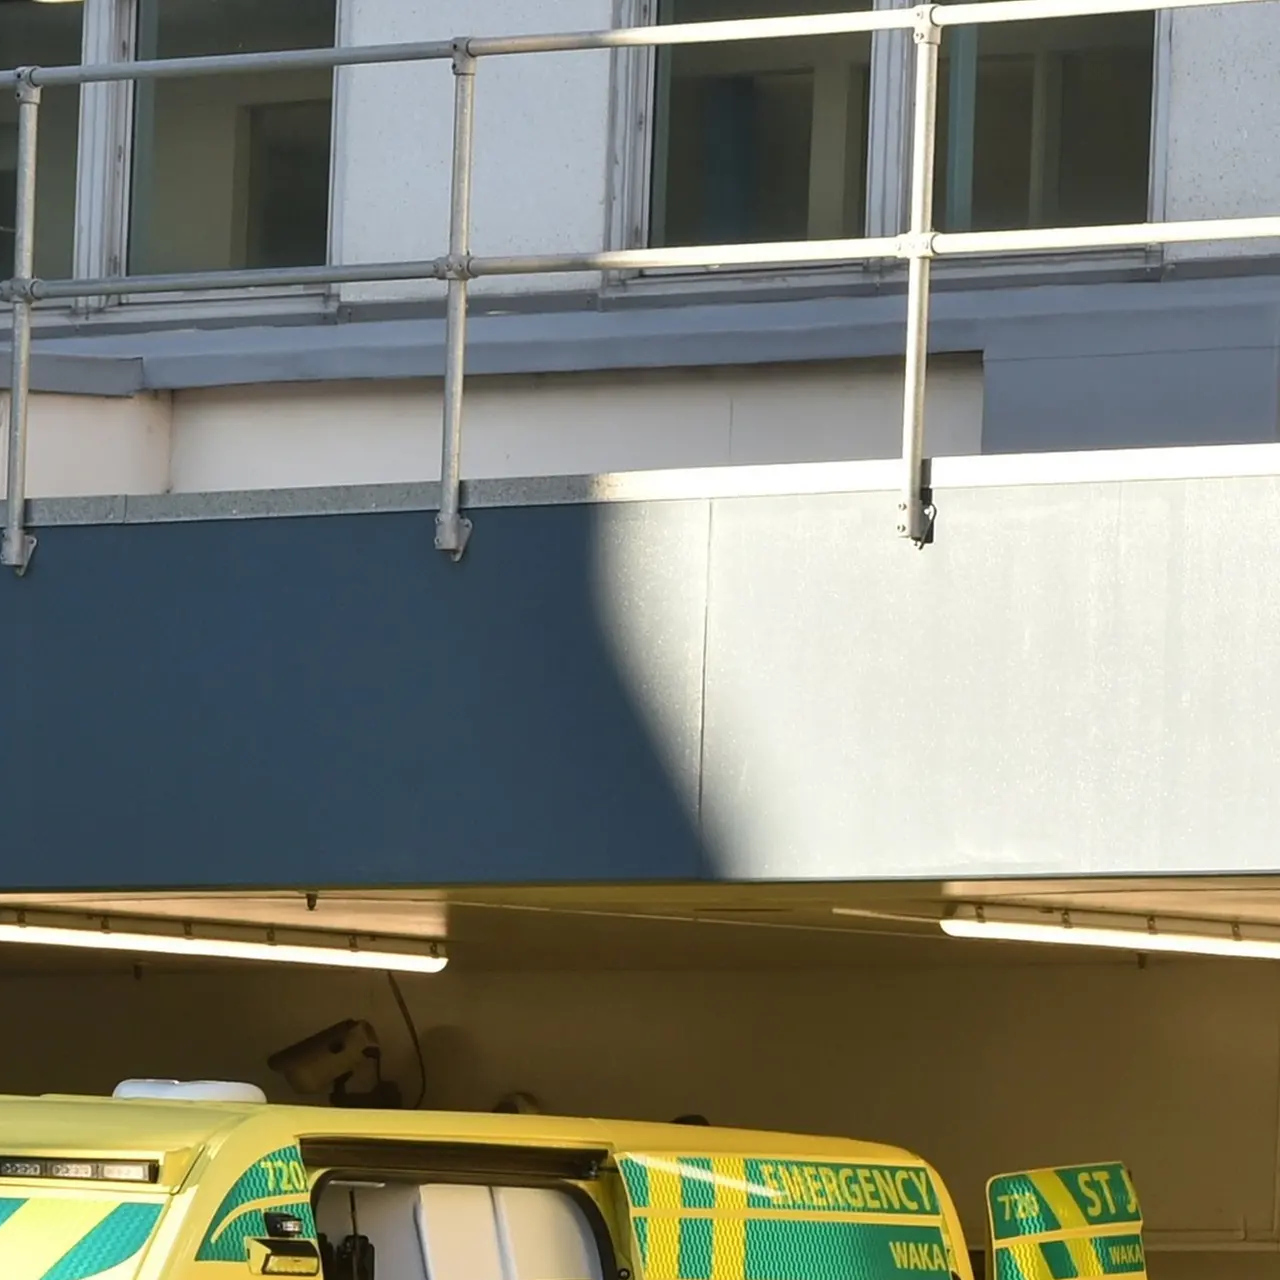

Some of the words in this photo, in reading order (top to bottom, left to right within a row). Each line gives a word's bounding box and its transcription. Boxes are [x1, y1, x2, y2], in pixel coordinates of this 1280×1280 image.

[260, 1159, 305, 1192] 720
[760, 1163, 933, 1212] EMERGENCY
[1077, 1170, 1116, 1217] ST
[888, 1240, 949, 1271] WAKA
